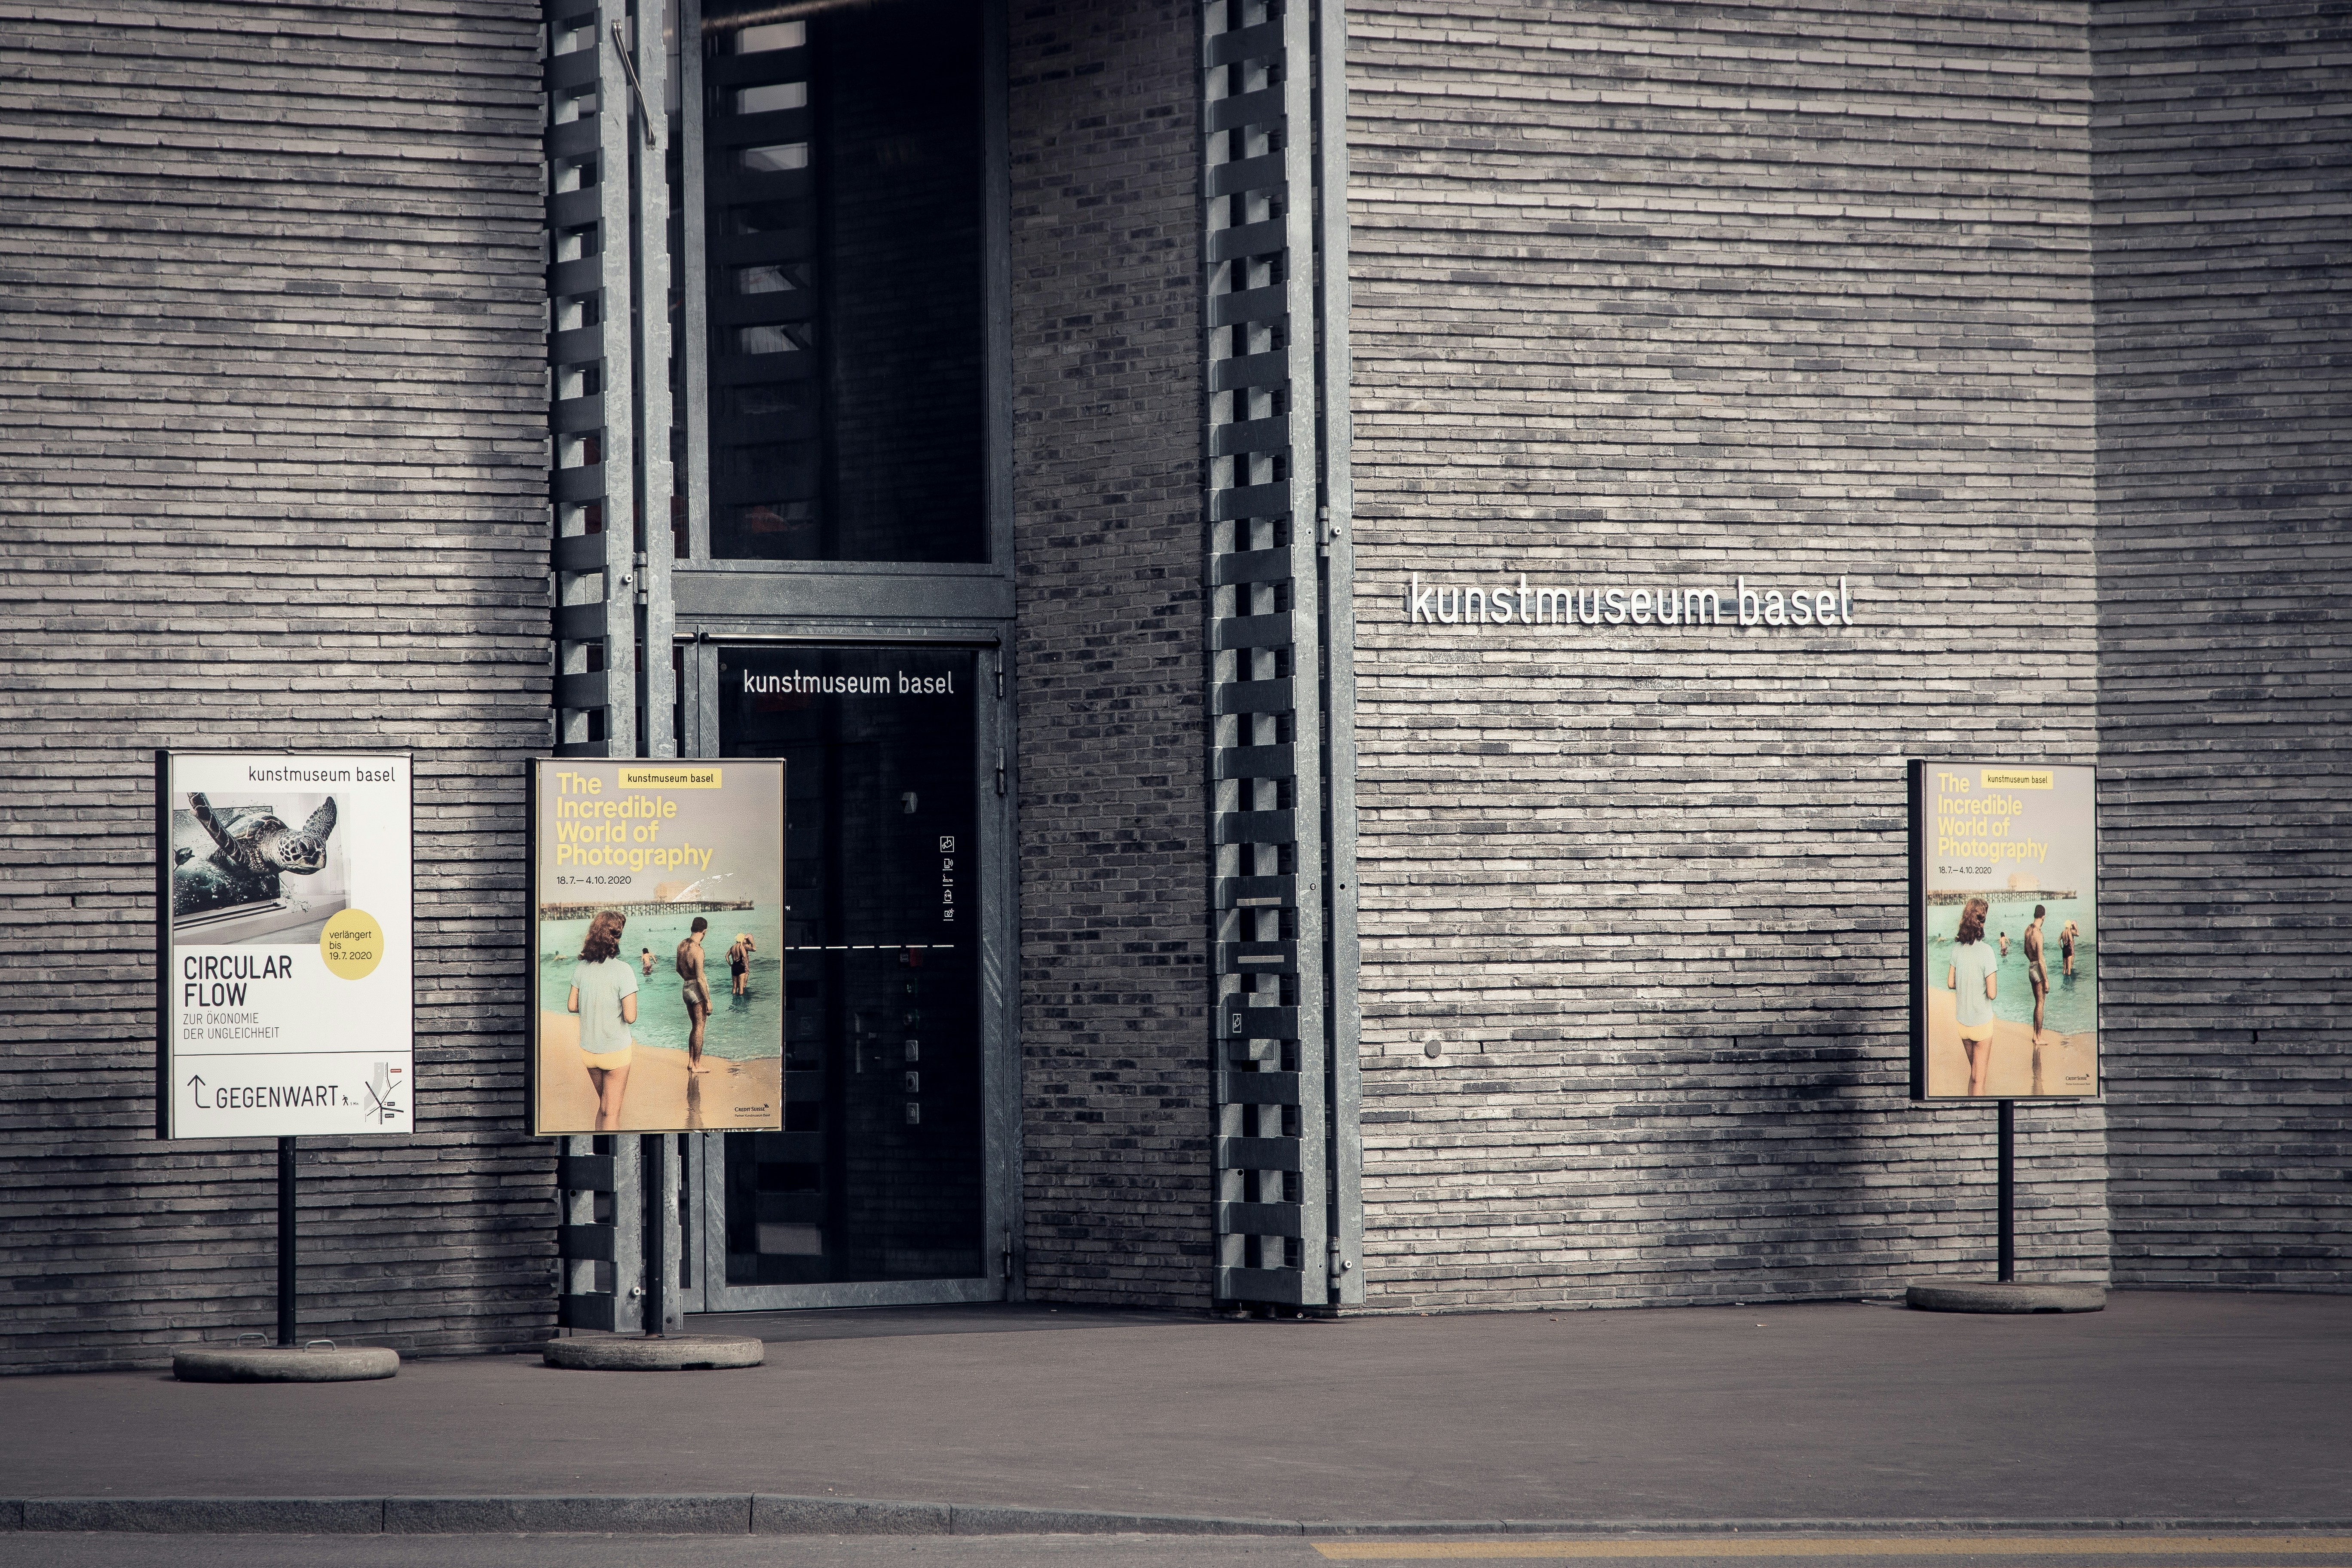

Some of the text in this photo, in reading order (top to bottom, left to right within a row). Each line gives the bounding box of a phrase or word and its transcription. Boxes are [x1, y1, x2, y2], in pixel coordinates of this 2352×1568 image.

[1412, 572, 1853, 625] kunstmuseum basel
[744, 669, 954, 694] kunstmuseum basel
[249, 766, 395, 782] kunstmuseum basel
[556, 772, 602, 795] The
[628, 773, 714, 783] kunstmuseum basel
[1937, 772, 1970, 793] The
[1988, 775, 2048, 784] kunstmuseum basel
[557, 795, 677, 818] Incredible
[1938, 794, 2022, 815] Incredible
[556, 820, 659, 843] World of
[1938, 817, 2010, 837] World of
[557, 843, 713, 872] Photography
[1938, 837, 2048, 864] Photography
[329, 930, 372, 941] verlängert
[329, 941, 342, 949] bis
[184, 955, 292, 980] CIRCULAR
[185, 982, 247, 1008] FLOW
[183, 1011, 259, 1025] ZUR ÖKONOMIE
[184, 1027, 279, 1039] DER UNGLEICHHEIT
[216, 1085, 338, 1109] GEGENWART
